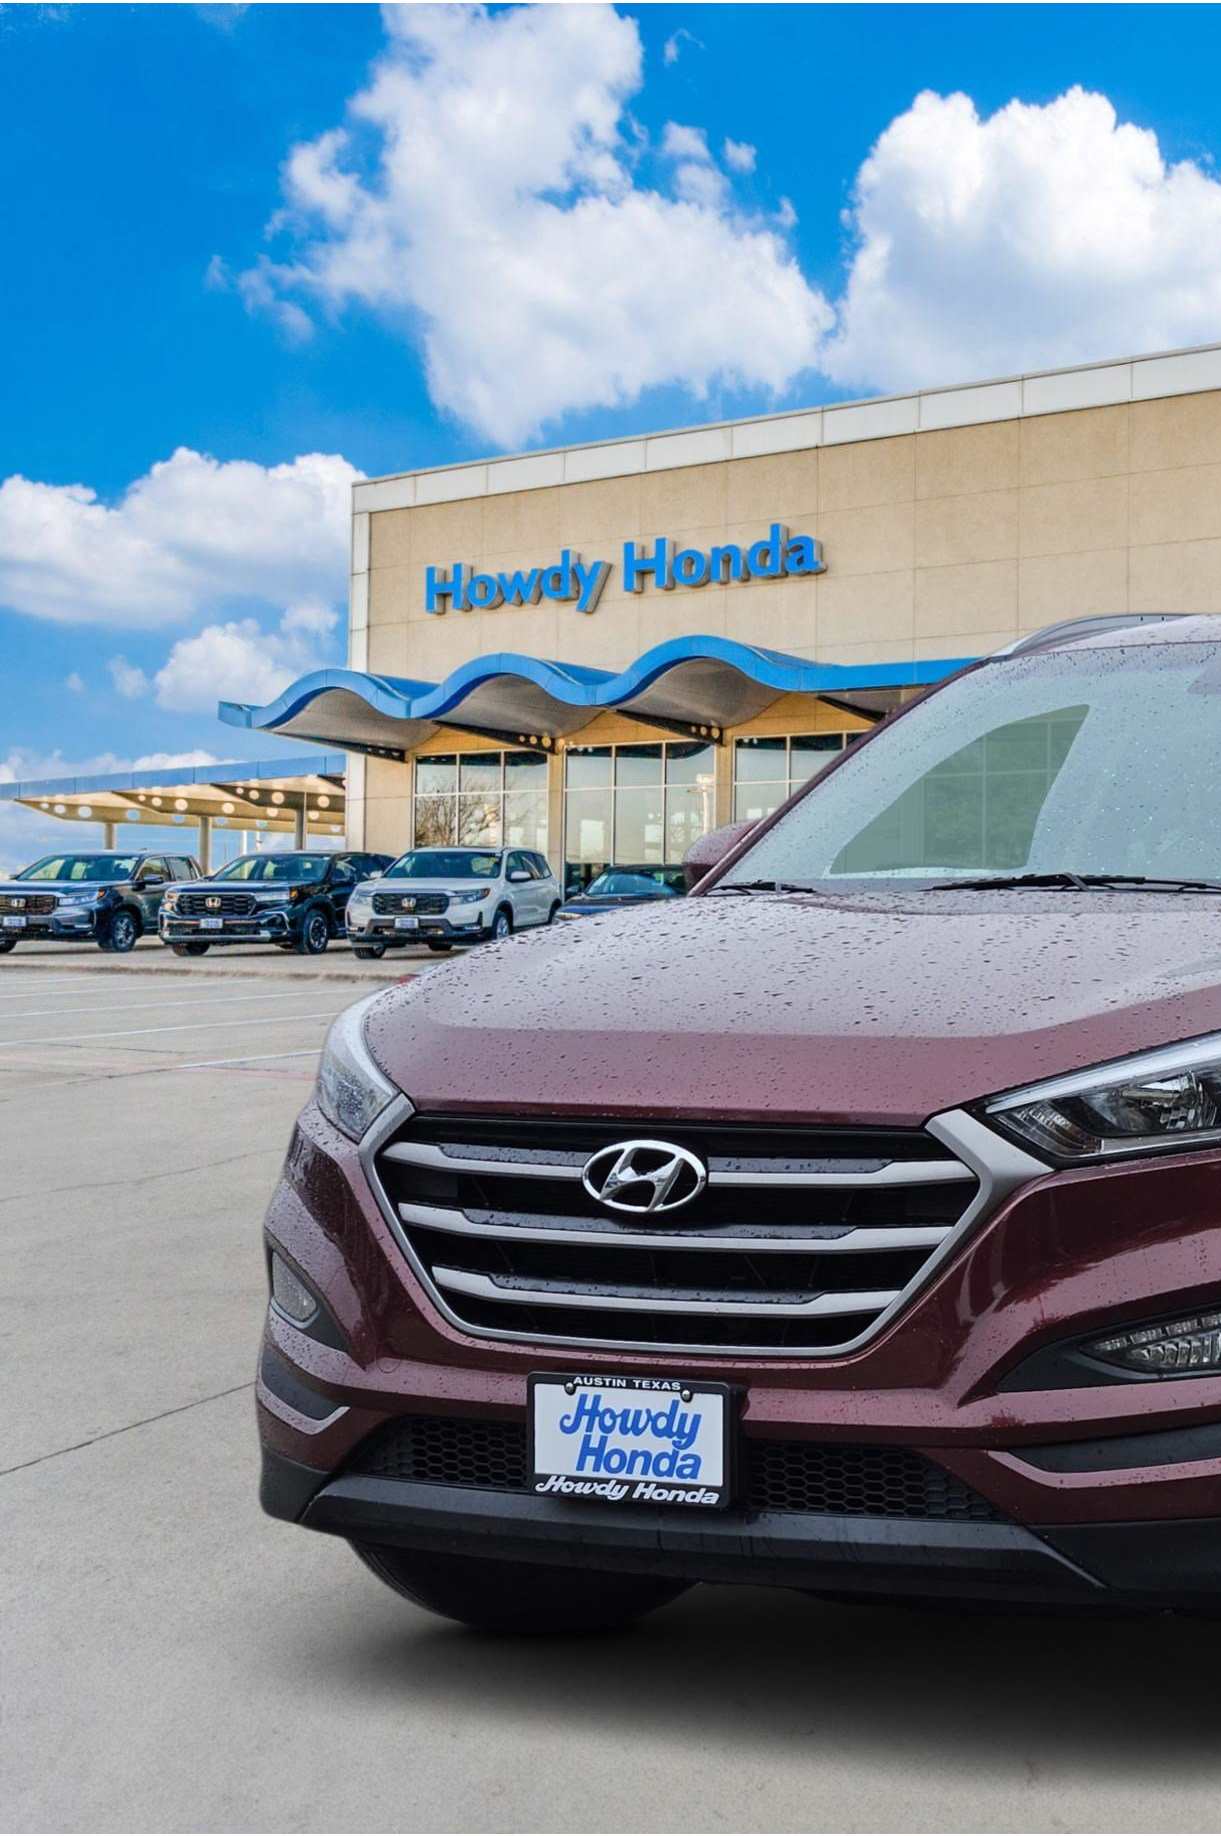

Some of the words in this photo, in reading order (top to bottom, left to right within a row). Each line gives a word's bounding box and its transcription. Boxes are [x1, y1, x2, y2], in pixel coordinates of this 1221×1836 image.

[425, 549, 612, 615] Howdy
[623, 523, 827, 593] Honda
[573, 1376, 627, 1388] AUSTIN
[633, 1380, 681, 1391] TEXAS
[559, 1394, 702, 1450] Howdy
[575, 1435, 702, 1480] Honda
[535, 1475, 629, 1500] Howdy
[632, 1483, 720, 1504] Honda
